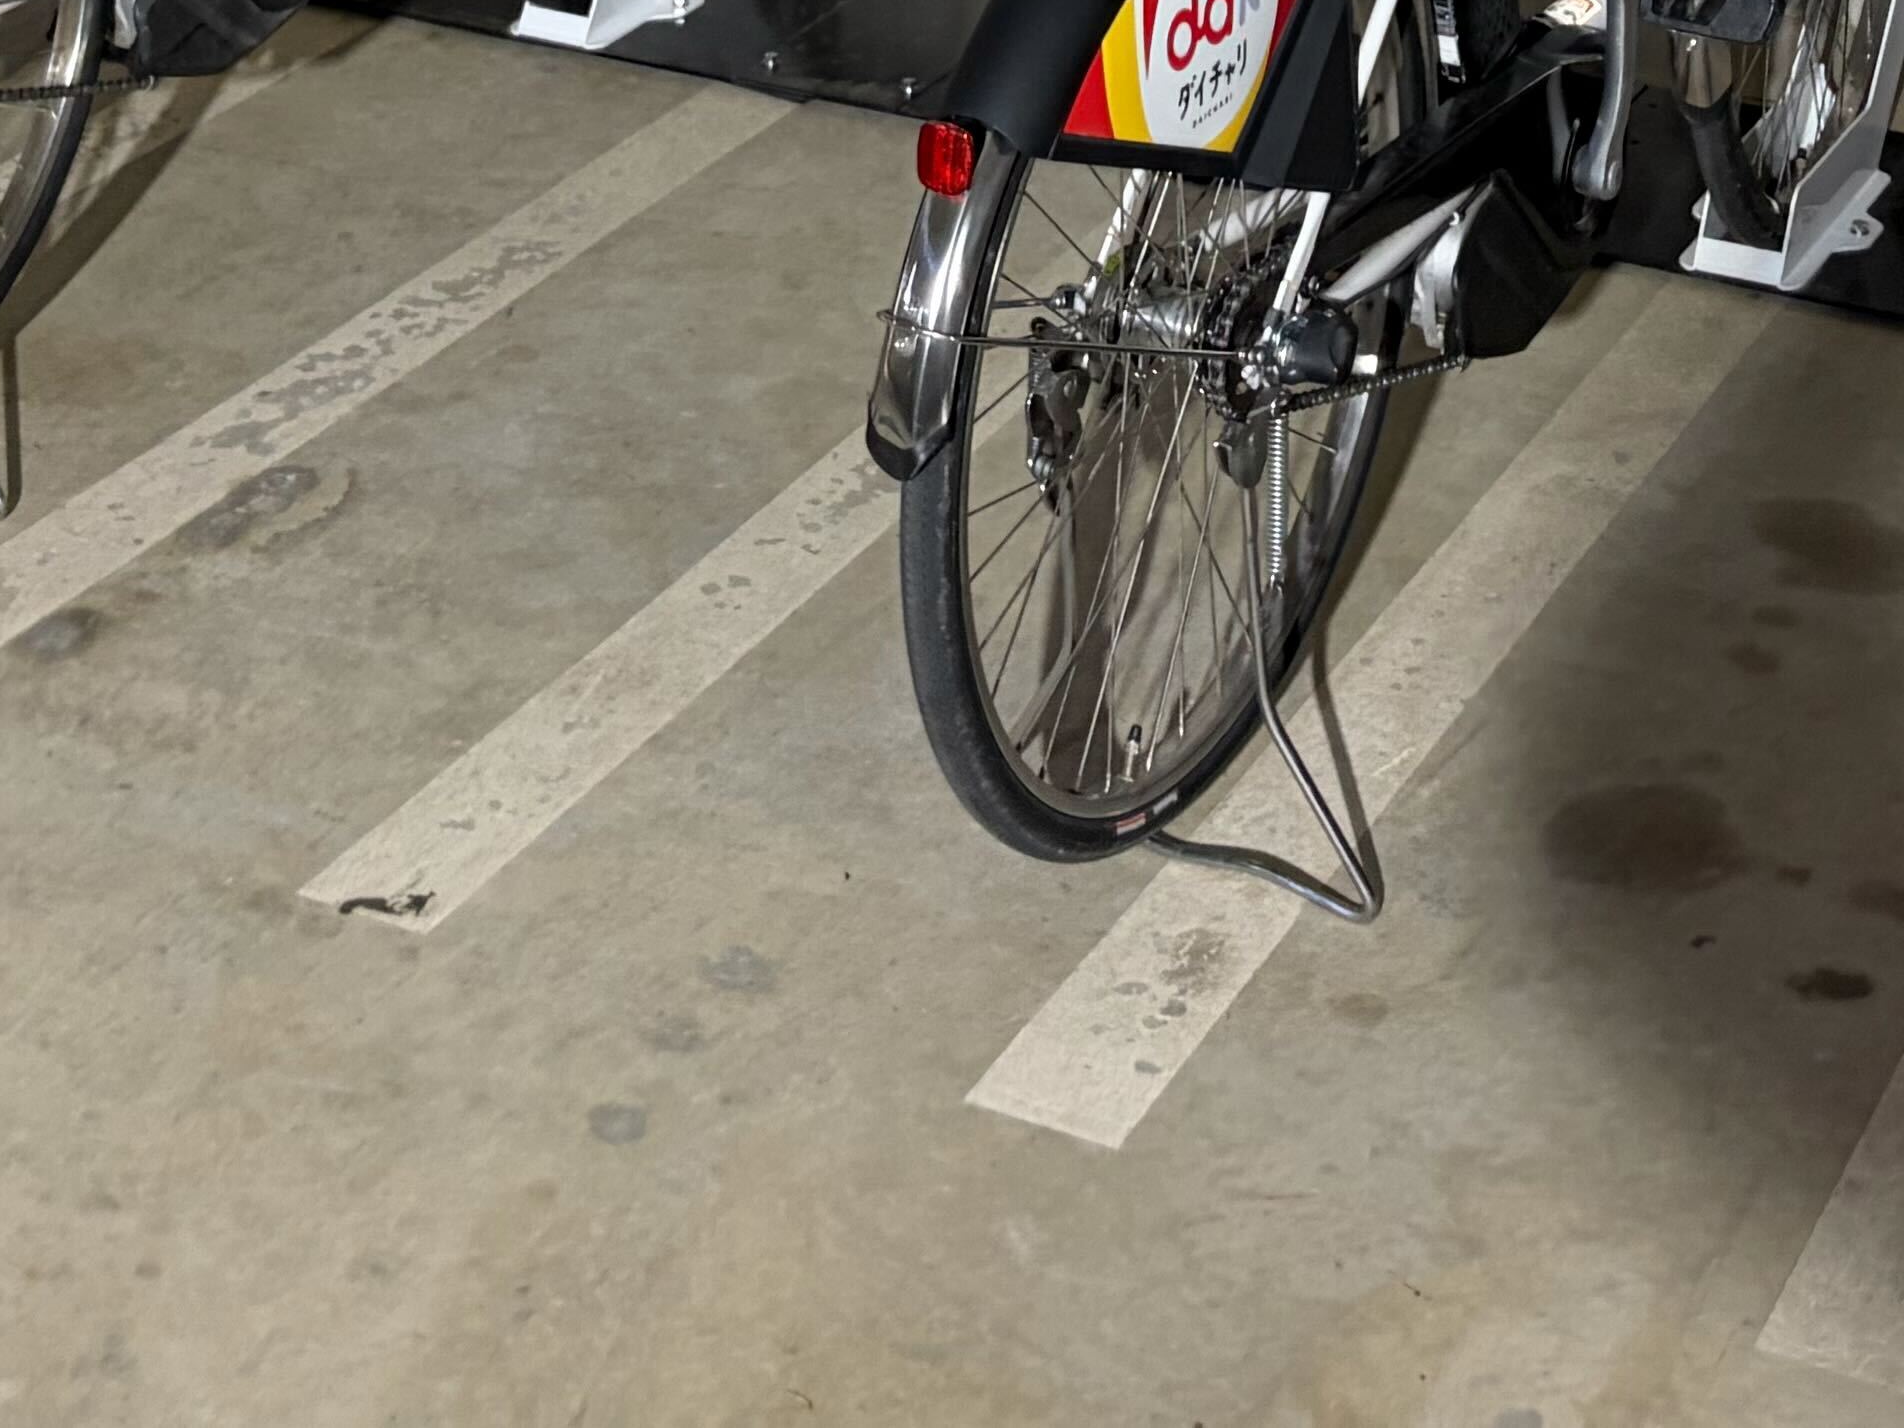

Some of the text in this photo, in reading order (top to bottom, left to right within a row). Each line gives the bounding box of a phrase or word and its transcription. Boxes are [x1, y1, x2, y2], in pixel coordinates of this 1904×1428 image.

[1179, 39, 1247, 121] ダイチャリ
